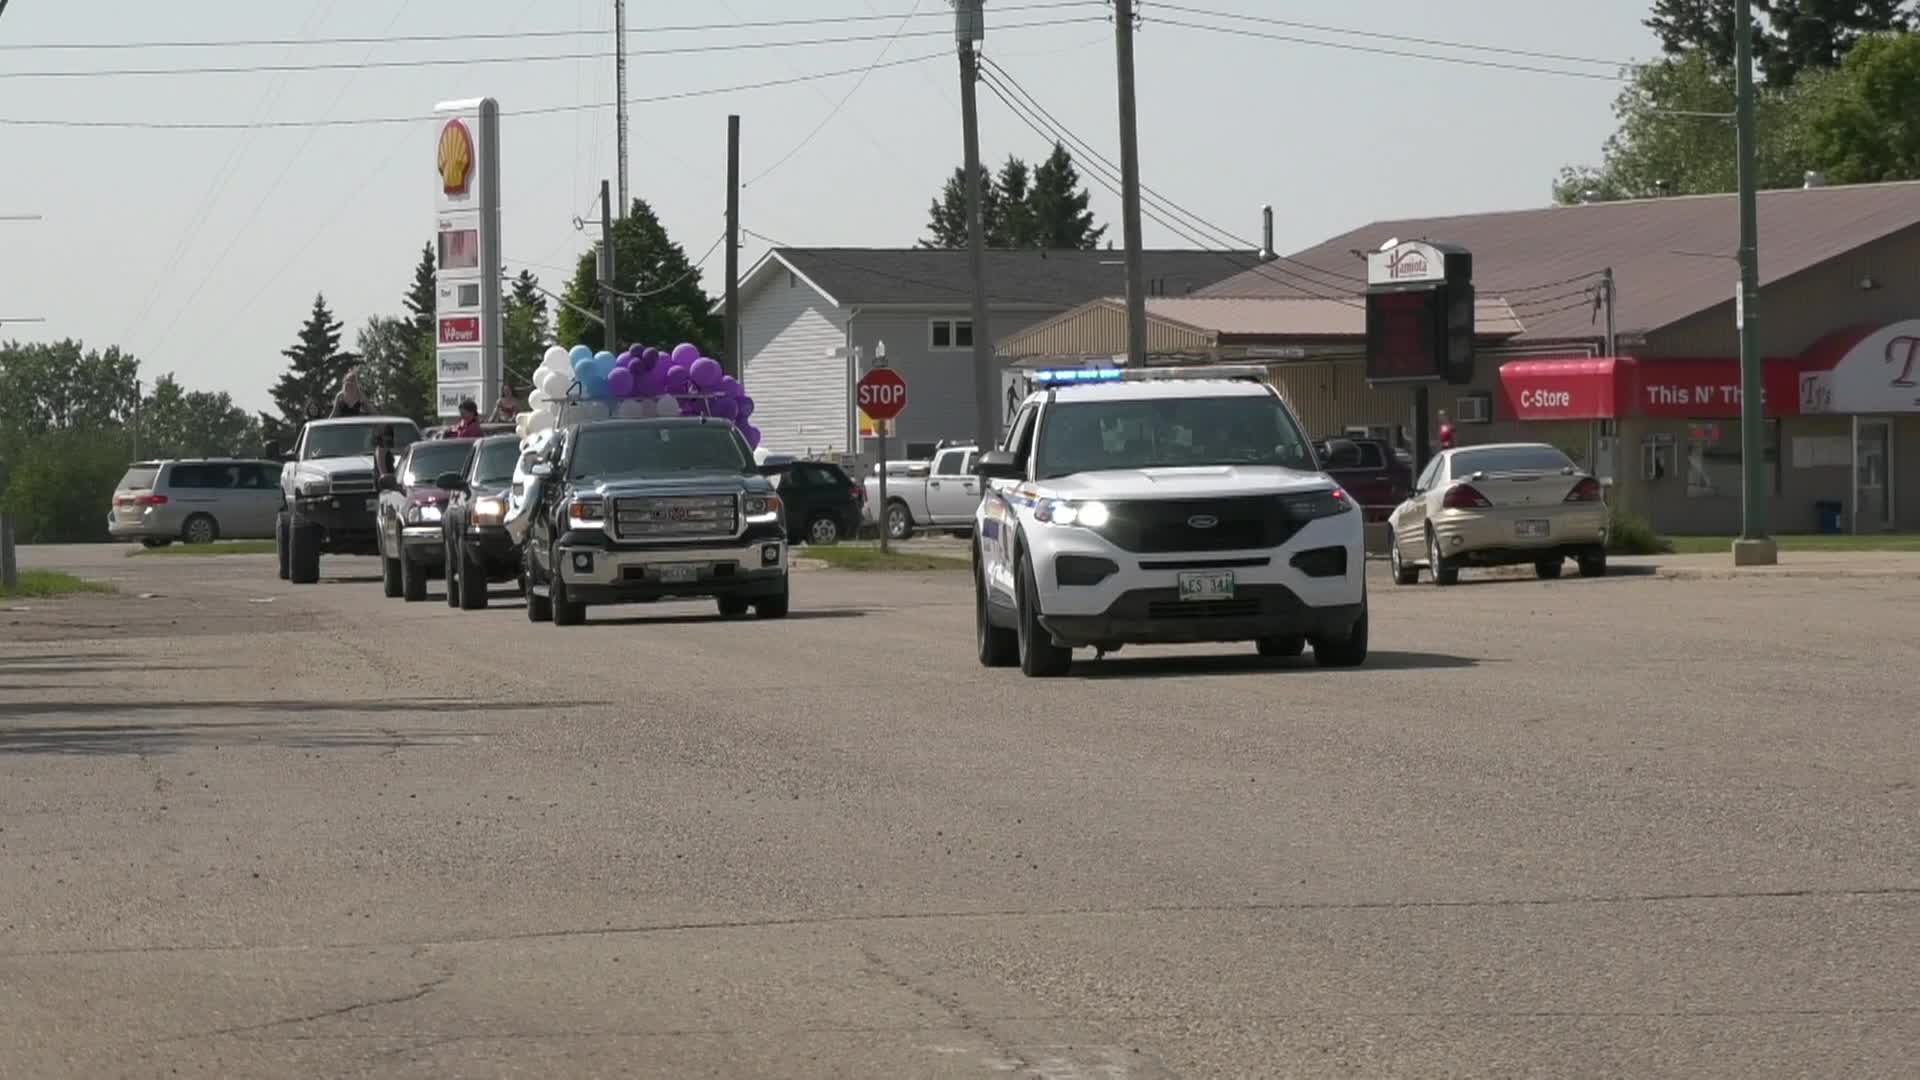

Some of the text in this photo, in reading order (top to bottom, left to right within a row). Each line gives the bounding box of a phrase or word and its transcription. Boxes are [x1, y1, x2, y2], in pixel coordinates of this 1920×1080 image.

[859, 384, 904, 404] STOP
[1520, 389, 1570, 408] C-Store
[1647, 385, 1689, 405] This
[1720, 386, 1766, 404] Tht
